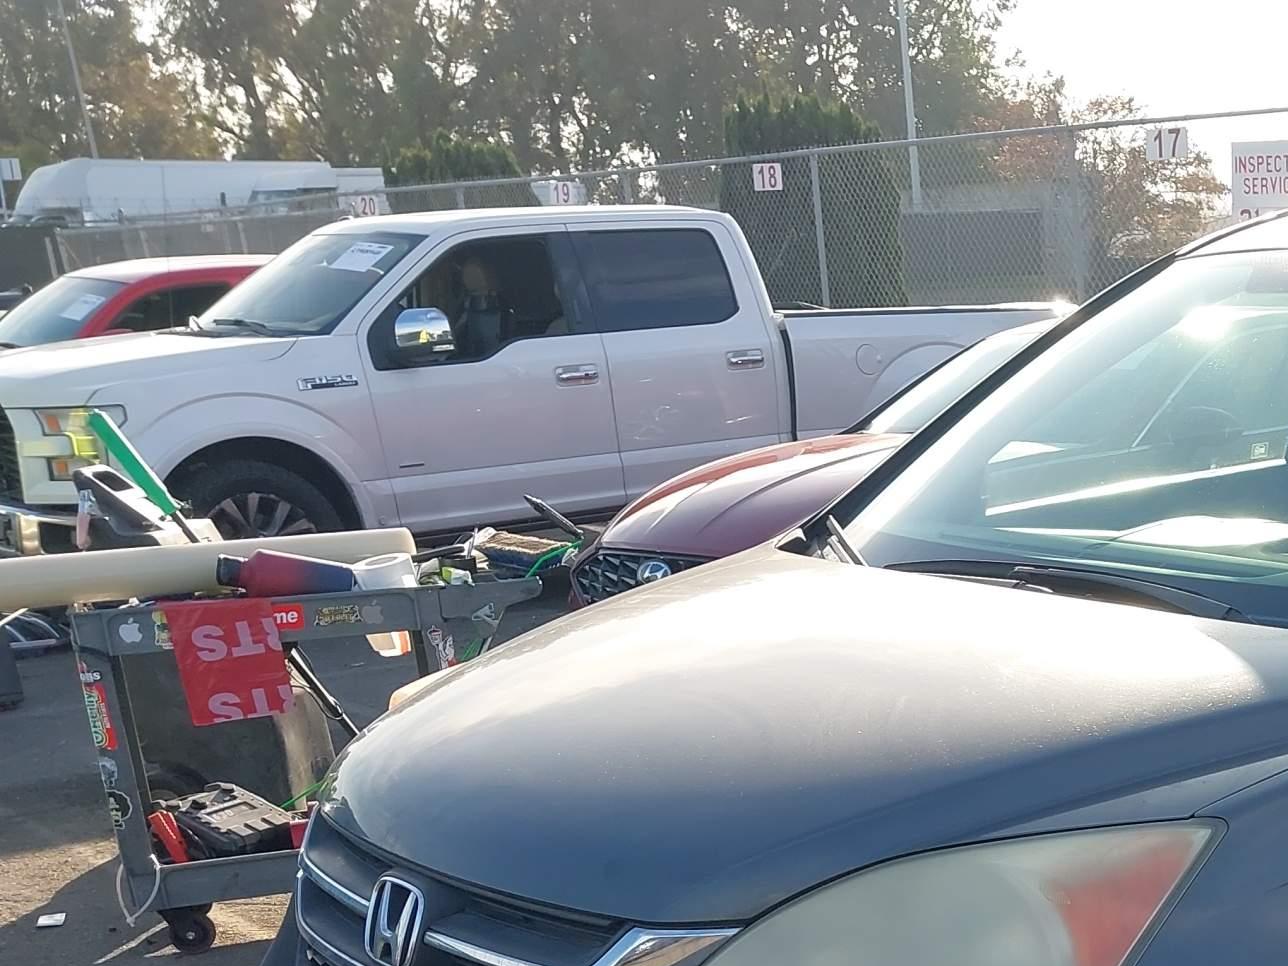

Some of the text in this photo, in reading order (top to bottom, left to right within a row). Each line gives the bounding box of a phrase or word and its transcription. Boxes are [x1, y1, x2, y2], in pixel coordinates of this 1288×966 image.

[1153, 128, 1181, 159] 17
[758, 165, 777, 189] 18
[553, 183, 570, 204] 19
[360, 197, 376, 216] 20
